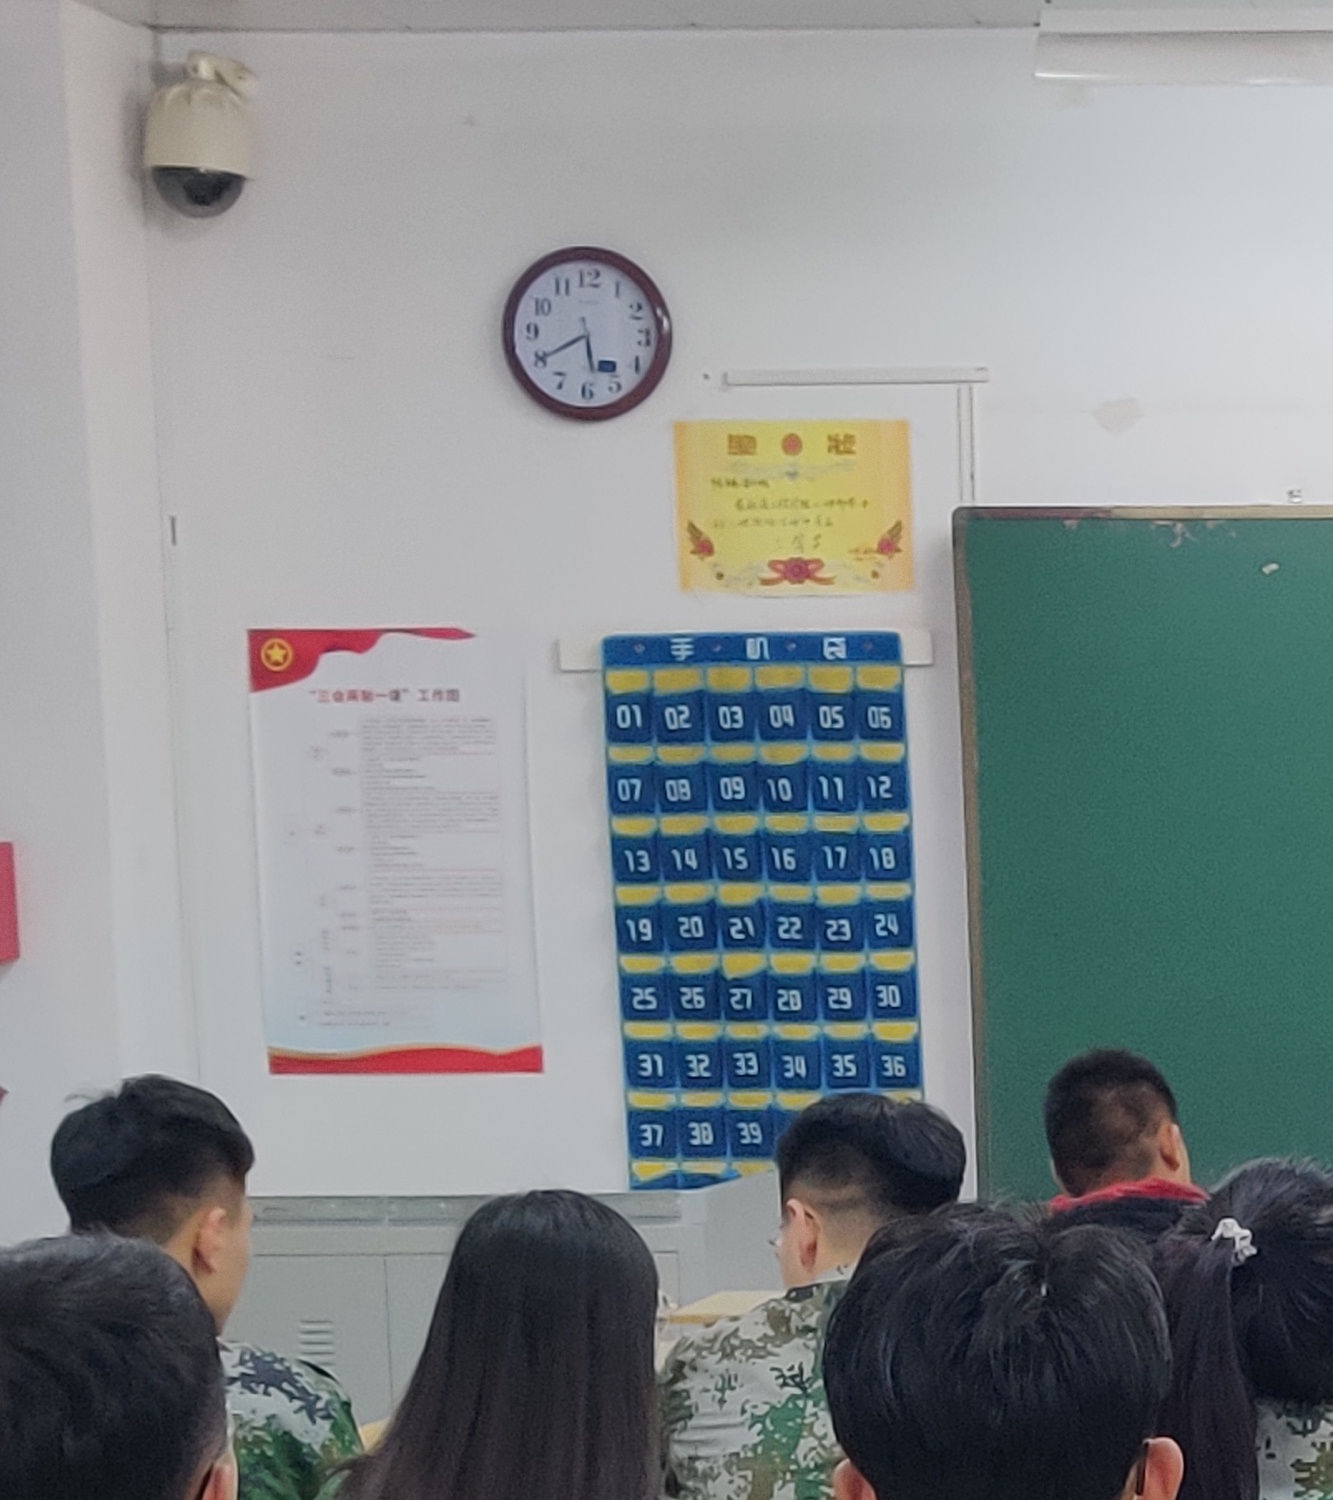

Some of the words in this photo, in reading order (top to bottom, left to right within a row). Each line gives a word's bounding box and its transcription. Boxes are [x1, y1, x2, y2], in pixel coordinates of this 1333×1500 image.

[555, 276, 571, 296] 11
[578, 269, 601, 289] 12
[534, 298, 551, 316] 10
[526, 322, 539, 341] 9
[552, 371, 566, 390] 7
[581, 381, 594, 400] 6
[616, 705, 642, 728] 01
[664, 706, 692, 730] 02
[718, 706, 744, 728] 03
[769, 705, 794, 728] 04
[818, 706, 844, 728] 05
[867, 706, 892, 729] 06
[617, 779, 642, 801] 07
[665, 779, 691, 801] 08
[720, 776, 746, 800] 09
[767, 778, 792, 800] 10
[818, 776, 844, 801] 11
[867, 776, 893, 798] 12
[624, 850, 650, 872] 13
[671, 849, 698, 870] 14
[722, 848, 748, 870] 15
[771, 848, 797, 870] 16
[822, 847, 847, 869] 17
[869, 847, 895, 869] 18
[626, 919, 652, 942] 19
[677, 916, 704, 938] 20
[728, 917, 755, 939] 21
[777, 917, 803, 939] 22
[825, 920, 851, 941] 23
[874, 914, 899, 936] 24
[632, 987, 657, 1010] 25
[680, 987, 706, 1009] 26
[729, 988, 752, 1010] 27
[777, 989, 802, 1011] 28
[827, 987, 852, 1010] 29
[876, 985, 901, 1008] 30
[637, 1054, 664, 1077] 31
[684, 1054, 712, 1078] 32
[732, 1052, 759, 1076] 33
[782, 1055, 807, 1079] 34
[831, 1054, 857, 1077] 35
[881, 1055, 907, 1078] 36
[639, 1124, 664, 1146] 37
[688, 1122, 714, 1145] 38
[736, 1122, 763, 1145] 39
